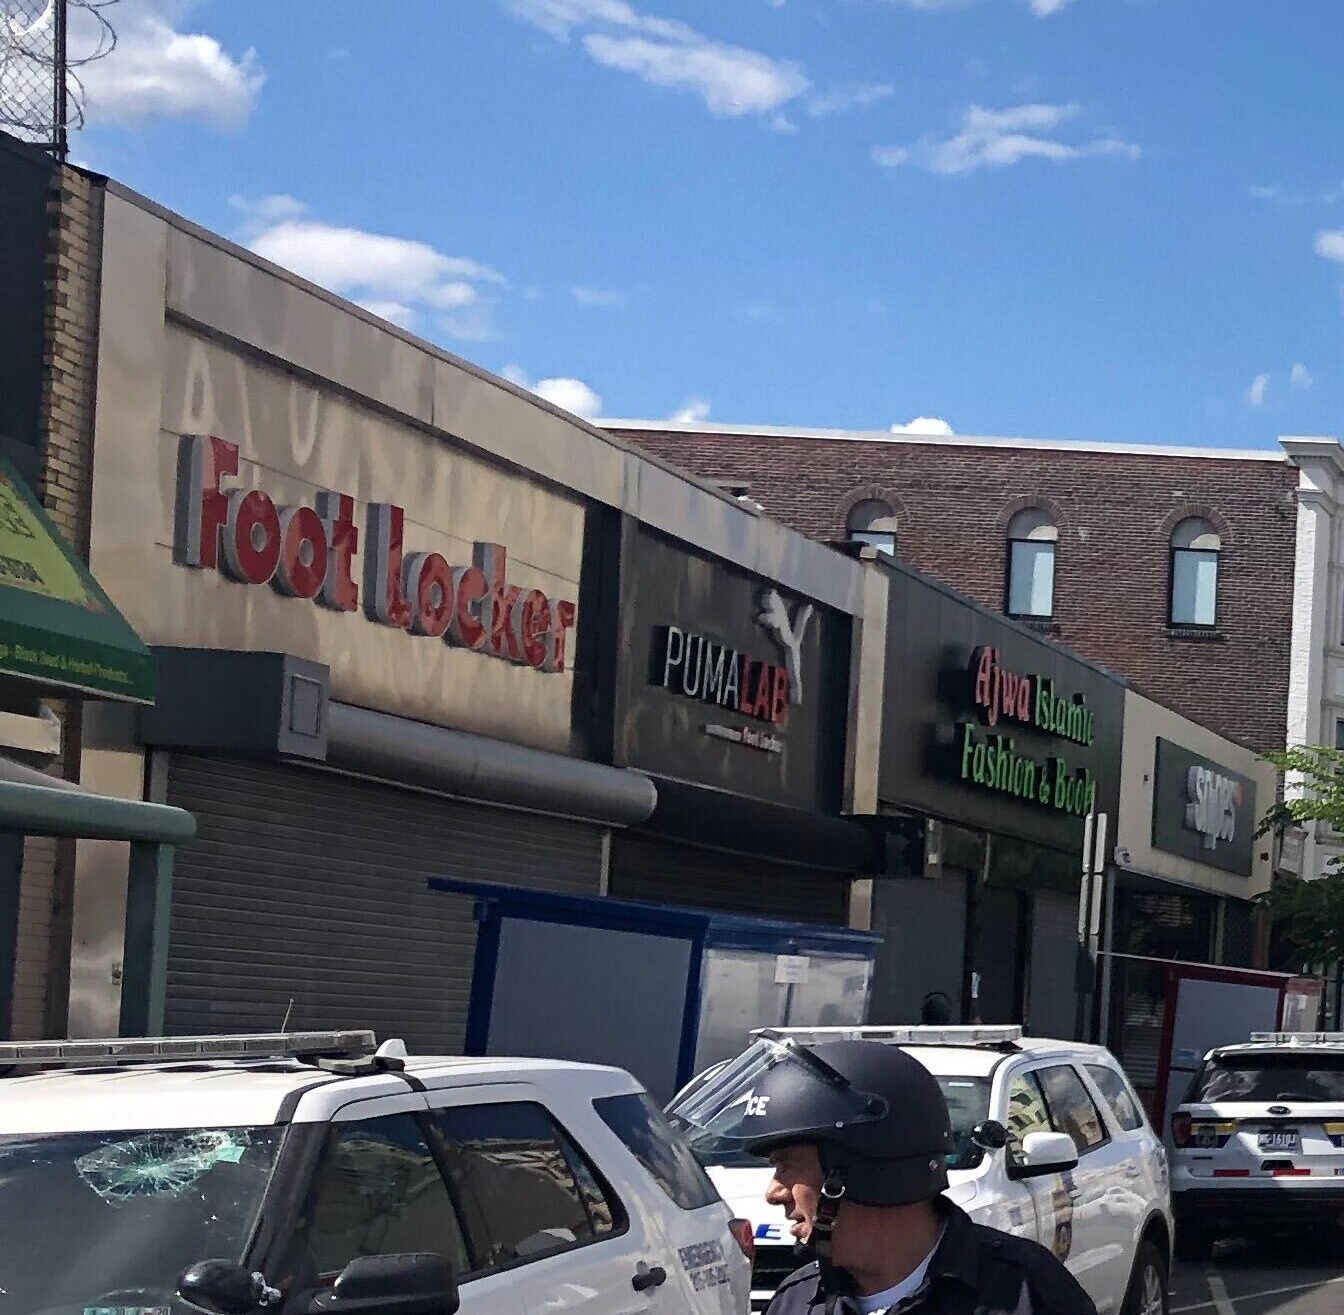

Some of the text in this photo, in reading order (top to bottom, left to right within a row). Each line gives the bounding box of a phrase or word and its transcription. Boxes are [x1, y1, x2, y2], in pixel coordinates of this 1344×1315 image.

[186, 434, 575, 674] Foot Locker
[975, 646, 1095, 748] Ajwa Islamic
[961, 723, 1035, 800] Fashion
